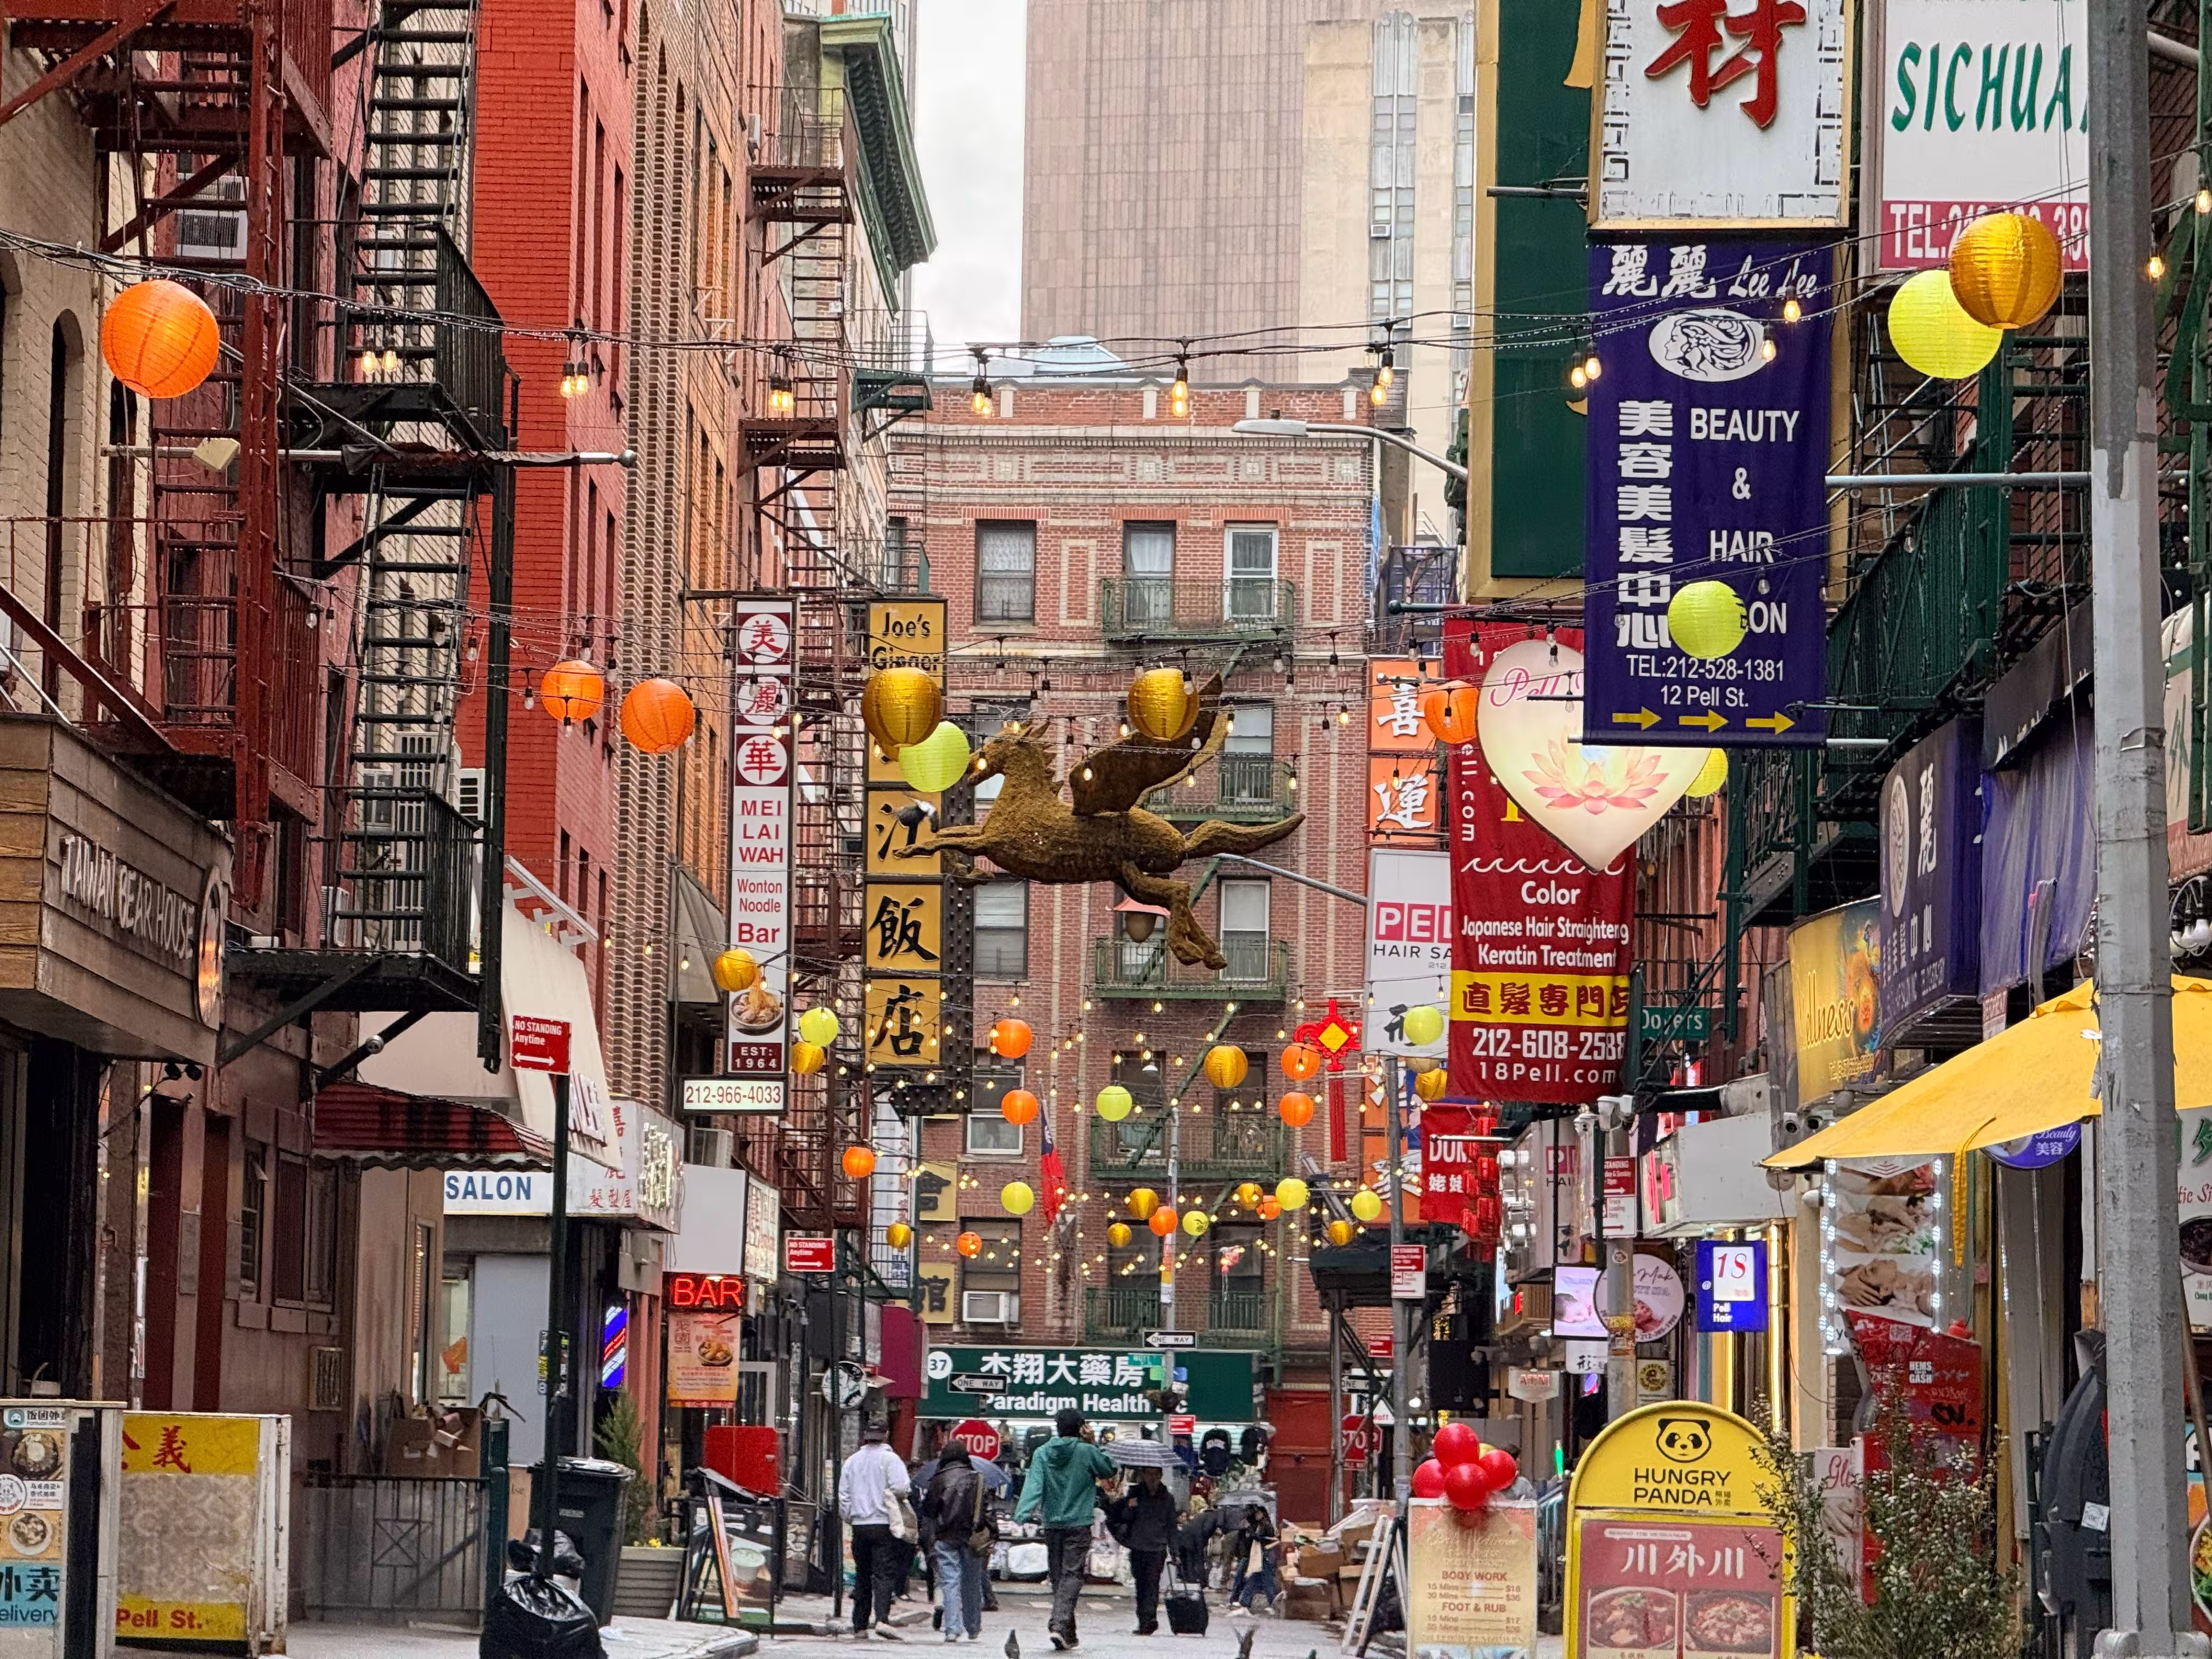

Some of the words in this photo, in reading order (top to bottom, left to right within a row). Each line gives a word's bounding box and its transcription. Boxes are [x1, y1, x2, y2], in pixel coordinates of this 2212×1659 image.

[1891, 41, 2087, 133] SICHUA
[1728, 255, 1770, 298] Lee
[1691, 408, 1799, 442] BEAUTY
[1732, 467, 1751, 500] &
[1710, 529, 1775, 563] HAIR
[882, 612, 930, 638] Joe's
[1748, 601, 1787, 634] ON
[1627, 654, 1784, 681] TEL:212-528-1381
[1661, 685, 1681, 706] 12
[1687, 685, 1719, 707] Pell
[1725, 687, 1749, 708] St.
[1462, 743, 1477, 842] ell.com
[741, 800, 782, 817] MEI
[743, 823, 780, 840] LAI
[738, 847, 784, 863] WAH
[737, 878, 782, 894] Wonton
[1521, 880, 1581, 905] Color
[740, 898, 781, 913] Noodle
[156, 882, 196, 960] HOUSE
[1462, 915, 1522, 942] Japanese
[1526, 915, 1555, 938] Hair
[738, 922, 781, 944] Bar
[1374, 944, 1421, 958] HAIR
[1479, 943, 1537, 966] Keratin
[1540, 944, 1617, 968] Treatment
[515, 1020, 526, 1031] NO
[527, 1021, 562, 1036] STANDING
[515, 1032, 546, 1046] Anytime
[741, 1046, 772, 1057] EST:
[1473, 1028, 1625, 1059] 212-608-2588
[735, 1058, 777, 1069] 1964
[685, 1086, 781, 1104] 212-966-4033
[445, 1175, 532, 1200] SALON
[674, 1277, 742, 1307] BAR
[1713, 1302, 1731, 1313] Pell
[1713, 1313, 1733, 1323] Hair
[929, 1359, 947, 1372] 37
[958, 1379, 974, 1387] ONE
[982, 1380, 999, 1388] WAY
[1519, 1374, 1550, 1387] ATM
[986, 1392, 1078, 1416] Paradigm
[1084, 1393, 1150, 1413] Health
[1634, 1468, 1731, 1486] HUNGRY
[1634, 1487, 1713, 1505] PANDA
[1621, 1543, 1744, 1579] 川外川
[1442, 1571, 1472, 1580] BODY
[1474, 1572, 1508, 1581] WORK
[116, 1607, 158, 1629] Pell
[170, 1607, 202, 1629] St.
[1442, 1602, 1470, 1612] FOOT
